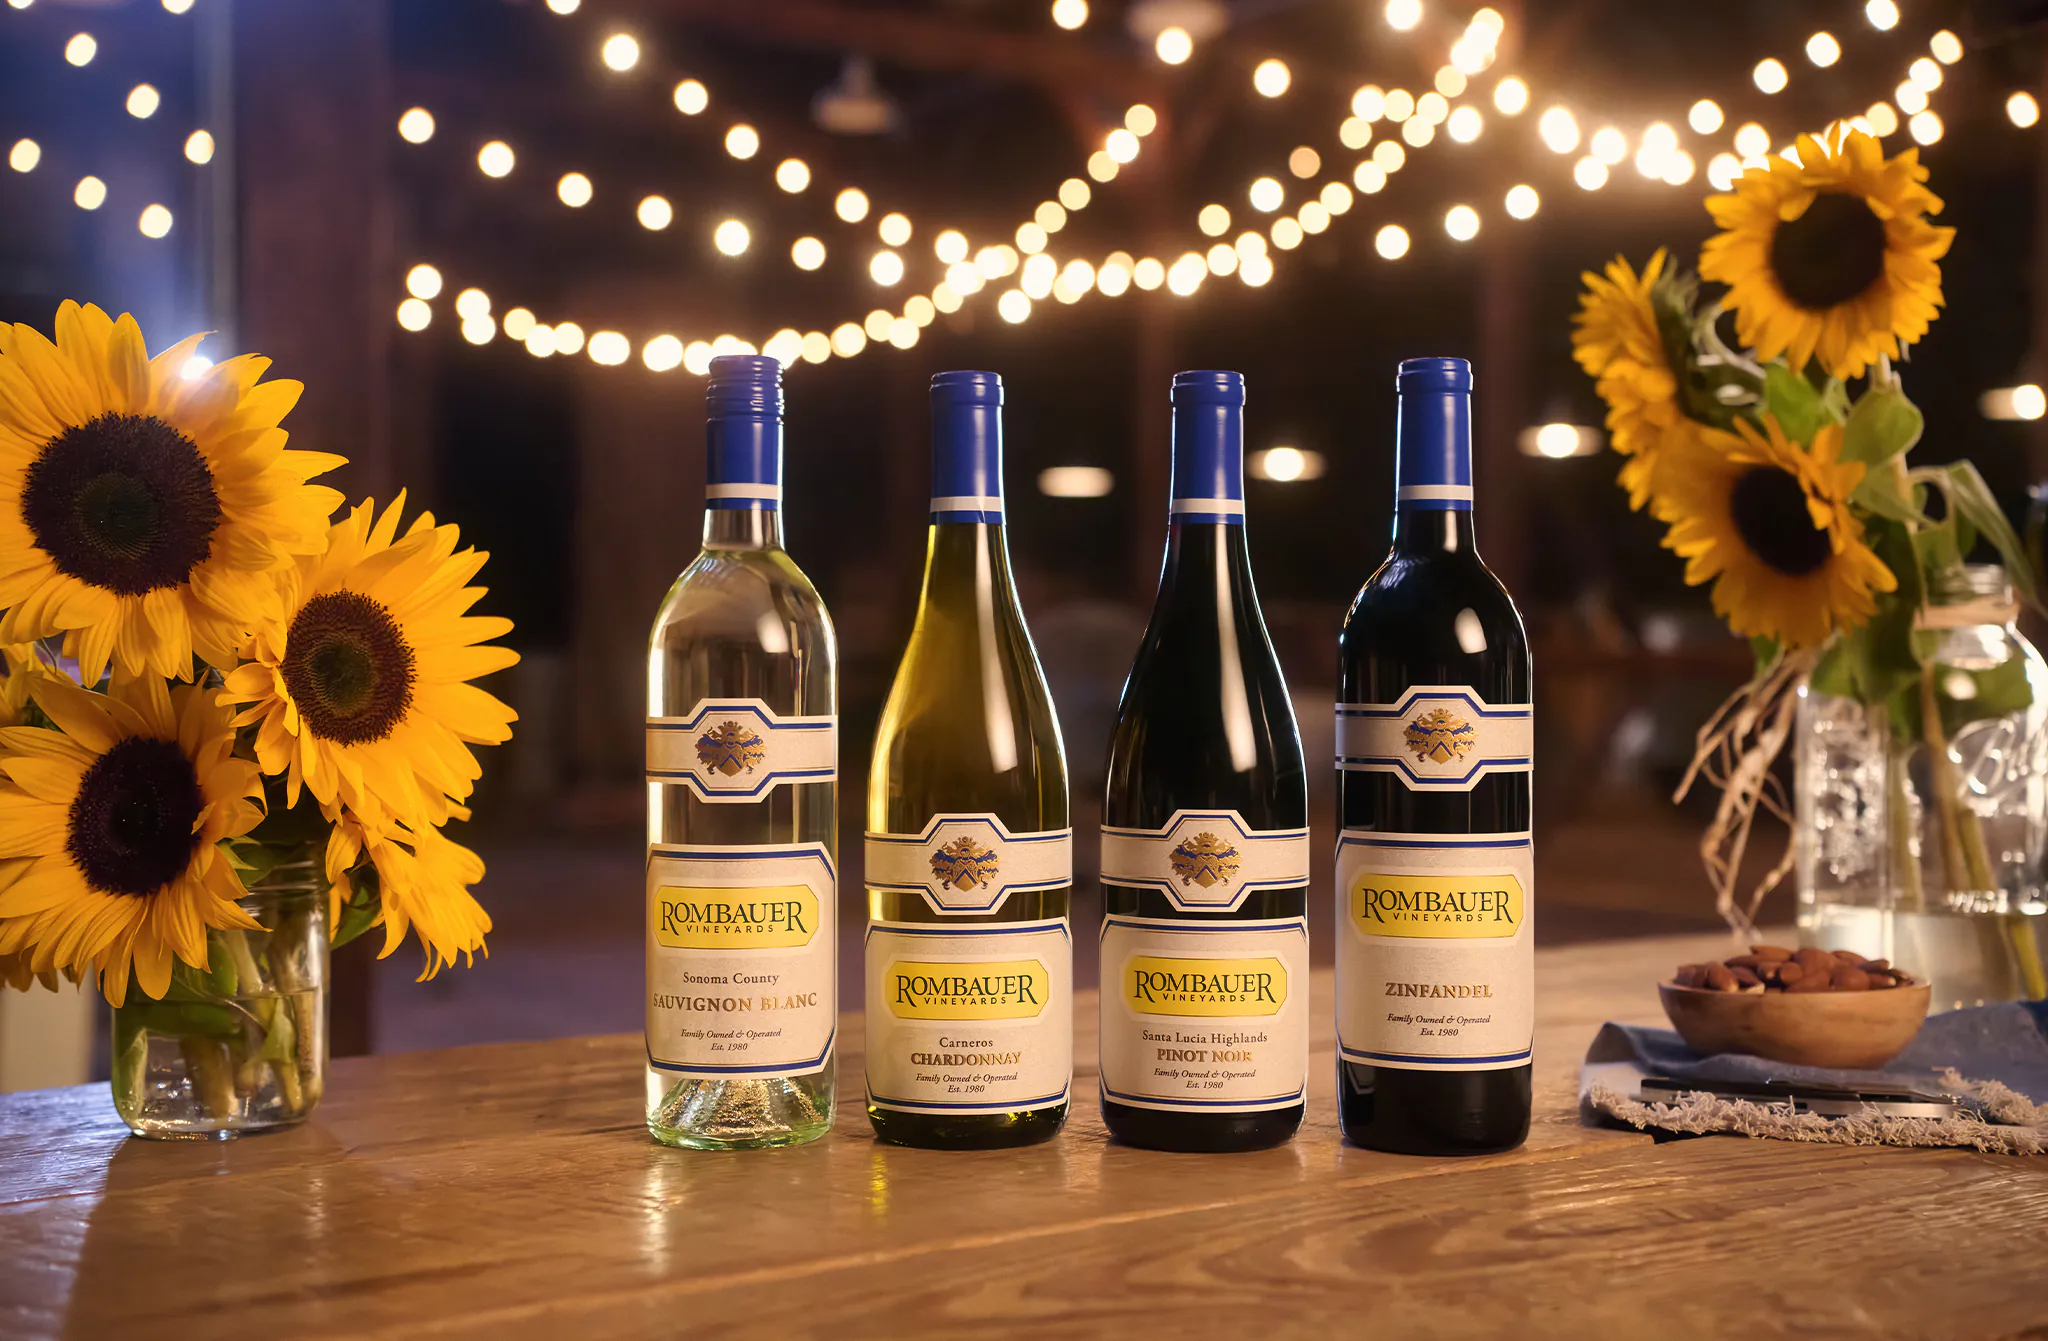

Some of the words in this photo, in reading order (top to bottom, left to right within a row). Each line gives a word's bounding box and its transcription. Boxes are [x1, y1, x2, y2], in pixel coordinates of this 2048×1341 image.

[1362, 889, 1513, 924] ROMBAUER
[661, 901, 807, 935] ROMBAUER
[1393, 913, 1483, 921] VINEYARDS
[686, 925, 773, 933] VINEYARDS
[683, 972, 728, 984] Sonoma
[733, 973, 779, 985] County
[896, 975, 1038, 1007] ROMBAUER
[1134, 971, 1276, 1003] ROMBAUER
[1385, 982, 1492, 998] ZINFANDEL
[654, 993, 752, 1012] SAUVIGNON
[761, 993, 817, 1011] BLANC
[924, 997, 1006, 1005] VINEYARDS
[1163, 994, 1246, 1002] VINEYARDS
[1388, 1014, 1414, 1024] Family
[1416, 1015, 1444, 1024] Owned
[1447, 1016, 1455, 1024] &
[1457, 1015, 1491, 1025] Operated
[681, 1029, 704, 1039] Family
[707, 1030, 734, 1038] Owned
[736, 1030, 744, 1038] &
[746, 1029, 781, 1039] Operated
[1420, 1028, 1434, 1036] Est.
[1438, 1028, 1458, 1036] 1980
[939, 1037, 993, 1048] Carneros
[1142, 1031, 1172, 1042] Santa
[1176, 1033, 1206, 1044] Lucia
[1211, 1033, 1268, 1046] Highlands
[711, 1043, 724, 1051] Est.
[728, 1043, 748, 1051] 1980
[911, 1052, 1022, 1065] CHARDONNAY
[1157, 1049, 1208, 1062] PINOT
[1212, 1050, 1253, 1062] NOIR
[916, 1074, 940, 1083] Family
[943, 1074, 970, 1083] Owned
[973, 1074, 981, 1082] &
[983, 1073, 1018, 1084] Operated
[1154, 1068, 1179, 1078] Family
[1182, 1070, 1209, 1079] Owned
[1211, 1070, 1220, 1078] &
[1222, 1070, 1256, 1080] Operated
[948, 1085, 961, 1093] Est.
[965, 1085, 984, 1093] 1980
[1186, 1081, 1200, 1089] Est.
[1203, 1081, 1223, 1089] 1980
